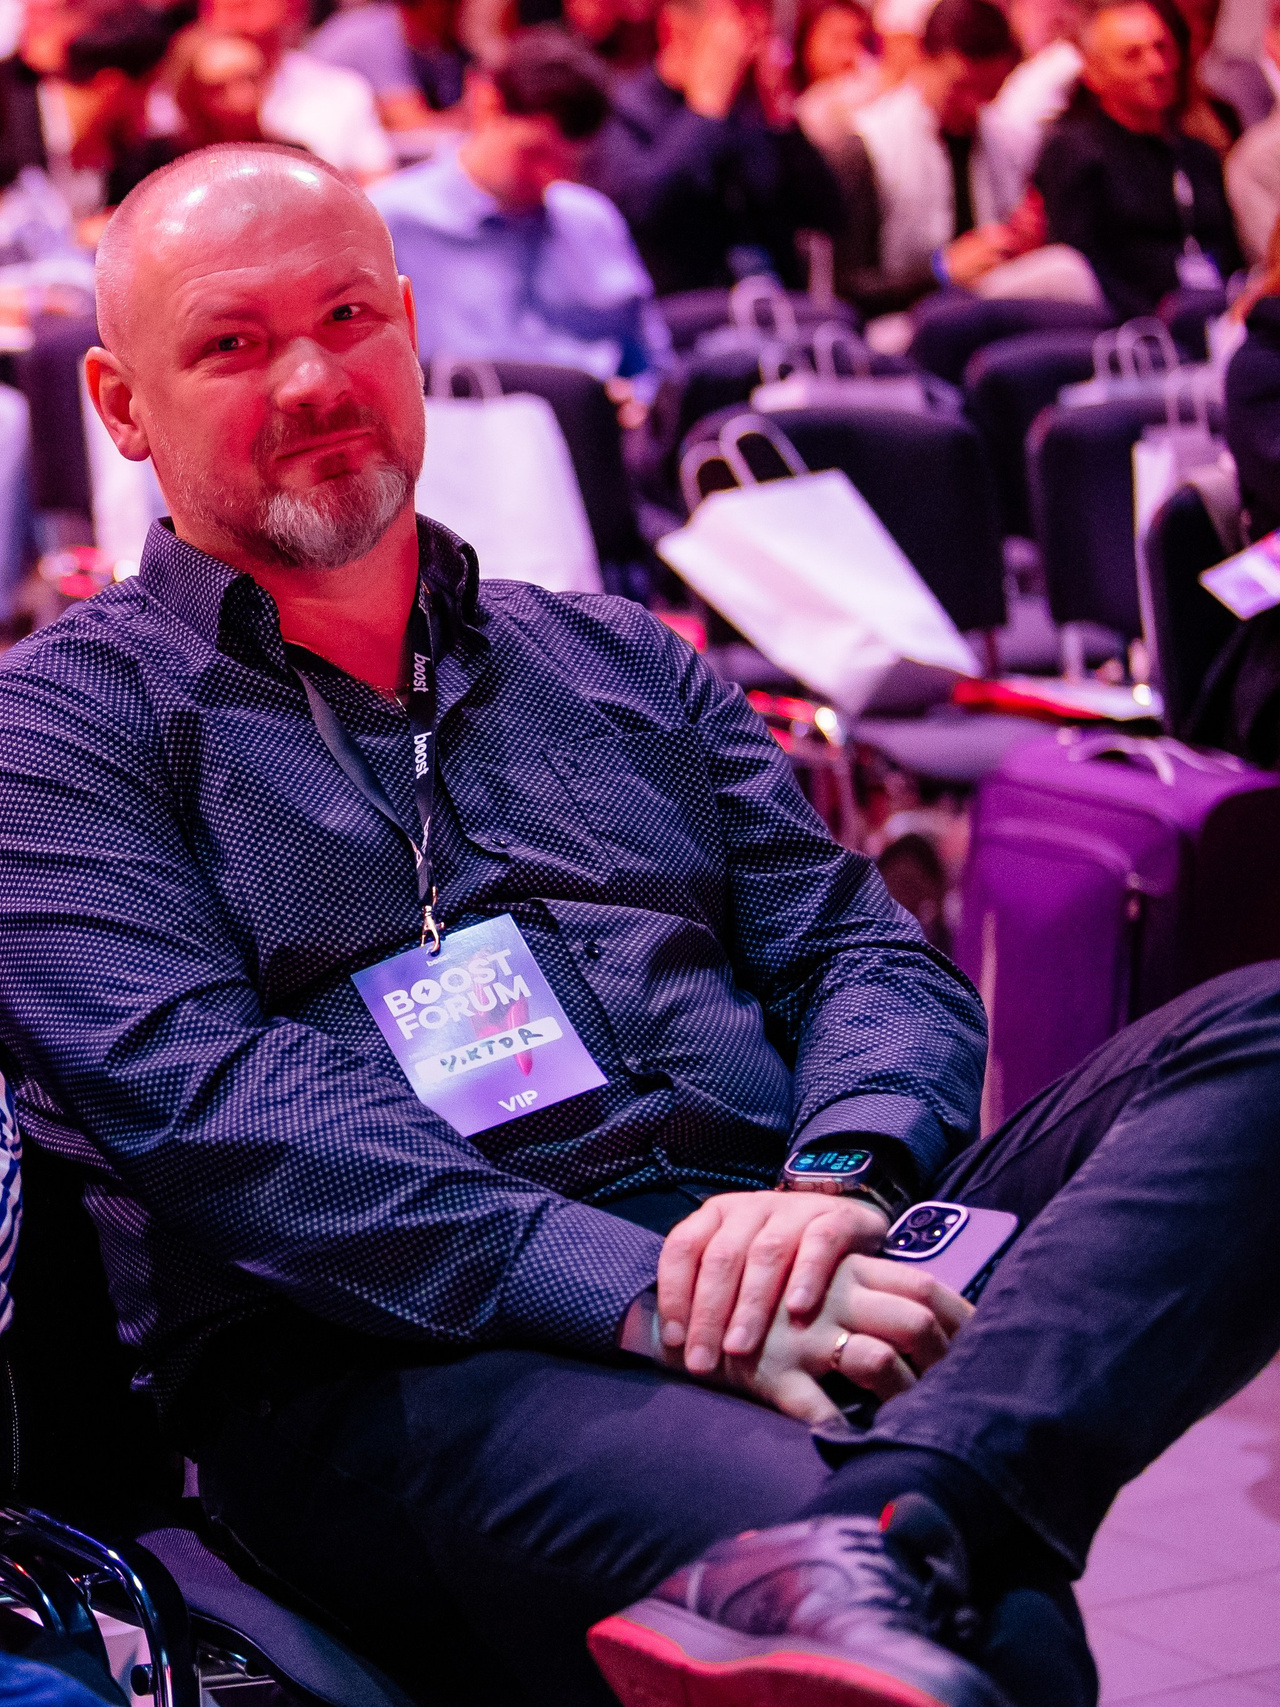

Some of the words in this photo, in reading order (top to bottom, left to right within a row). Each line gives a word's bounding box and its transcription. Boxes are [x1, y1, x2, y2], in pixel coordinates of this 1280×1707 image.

[413, 652, 431, 692] boost
[413, 731, 432, 779] boost
[382, 949, 513, 1018] BOOST
[395, 974, 532, 1040] FORUM
[497, 1089, 539, 1113] VIP
